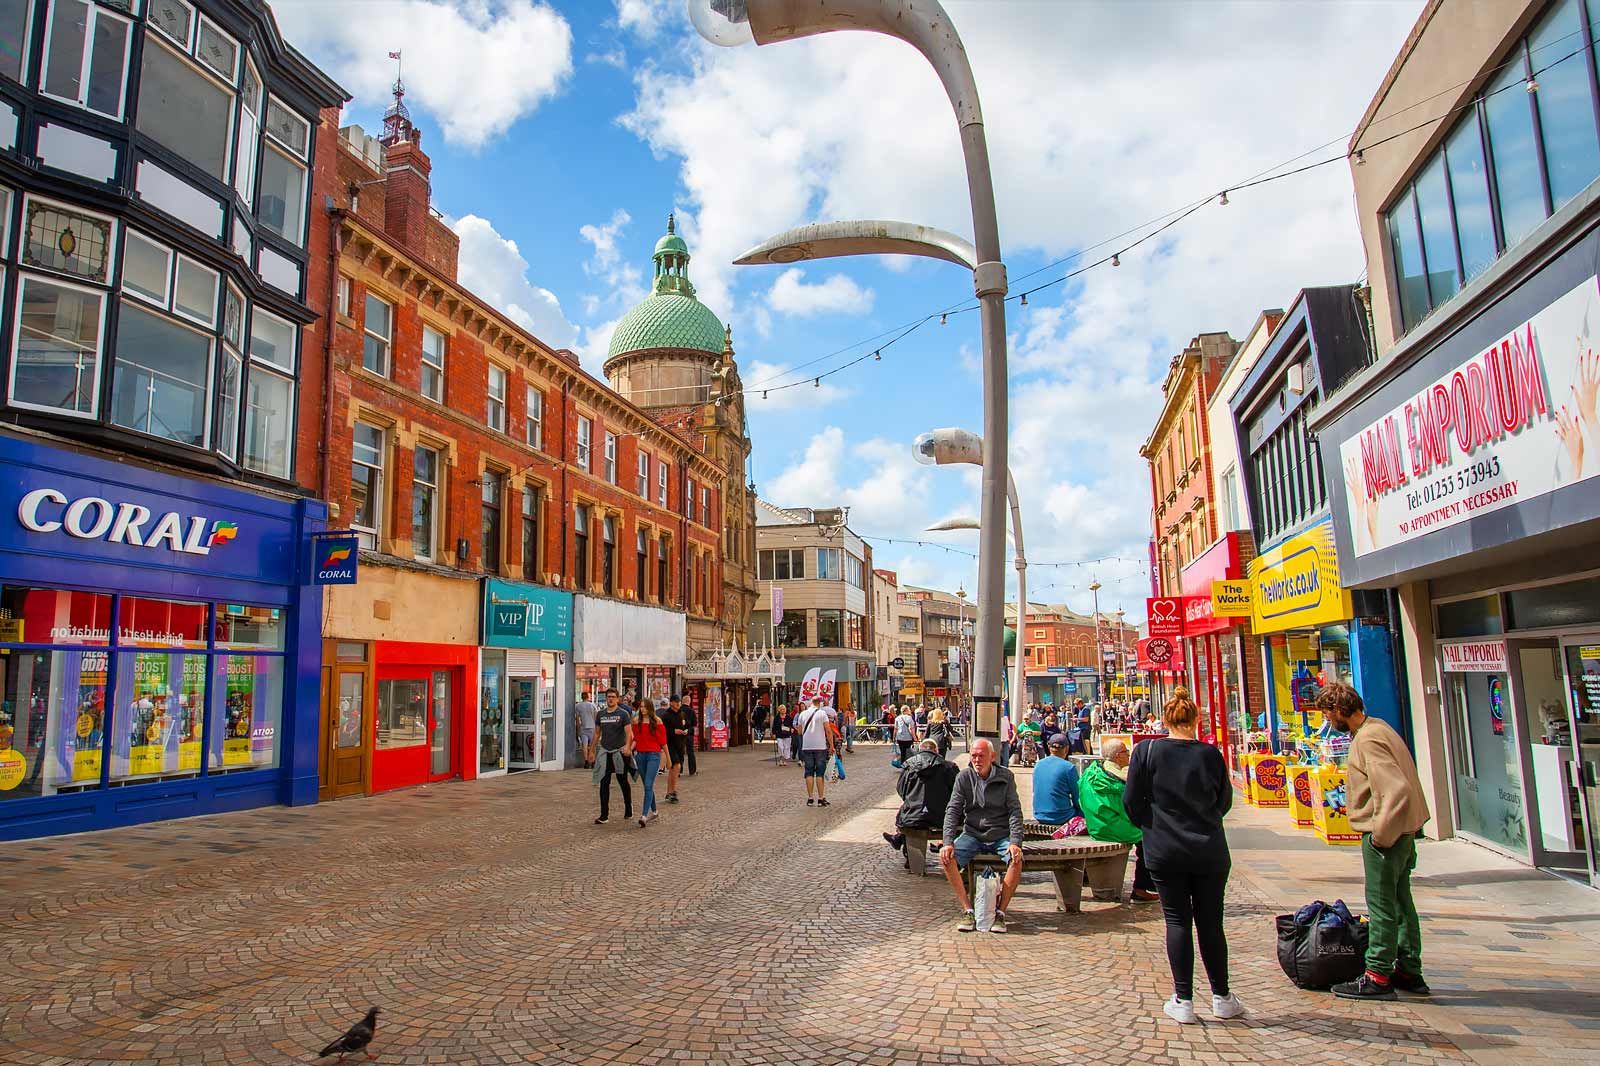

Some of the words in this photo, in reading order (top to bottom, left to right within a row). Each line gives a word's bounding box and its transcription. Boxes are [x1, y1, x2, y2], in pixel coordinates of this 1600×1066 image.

[1360, 415, 1406, 499] NAIL
[1404, 321, 1547, 477] EMPORIUM
[1406, 490, 1422, 511] Tel:
[1423, 475, 1454, 504] 01253
[1457, 455, 1500, 490] 573943
[1399, 522, 1409, 536] NO
[1410, 501, 1460, 532] APPOINTMENT
[1462, 480, 1519, 513] NECESSARY
[18, 488, 212, 555] CORAL
[319, 570, 352, 579] CORAL
[1223, 585, 1242, 594] The
[1260, 562, 1320, 606] TheWorks.co.uk
[1217, 595, 1250, 604] Works
[499, 612, 522, 625] VIP
[1443, 645, 1462, 663] NAIL
[134, 661, 166, 673] BOOST
[183, 662, 205, 673] BOOS
[227, 664, 252, 674] BOOST
[1255, 765, 1276, 776] Out
[1275, 764, 1286, 776] 2
[1261, 775, 1283, 787] Play
[1498, 787, 1521, 808] Beauty
